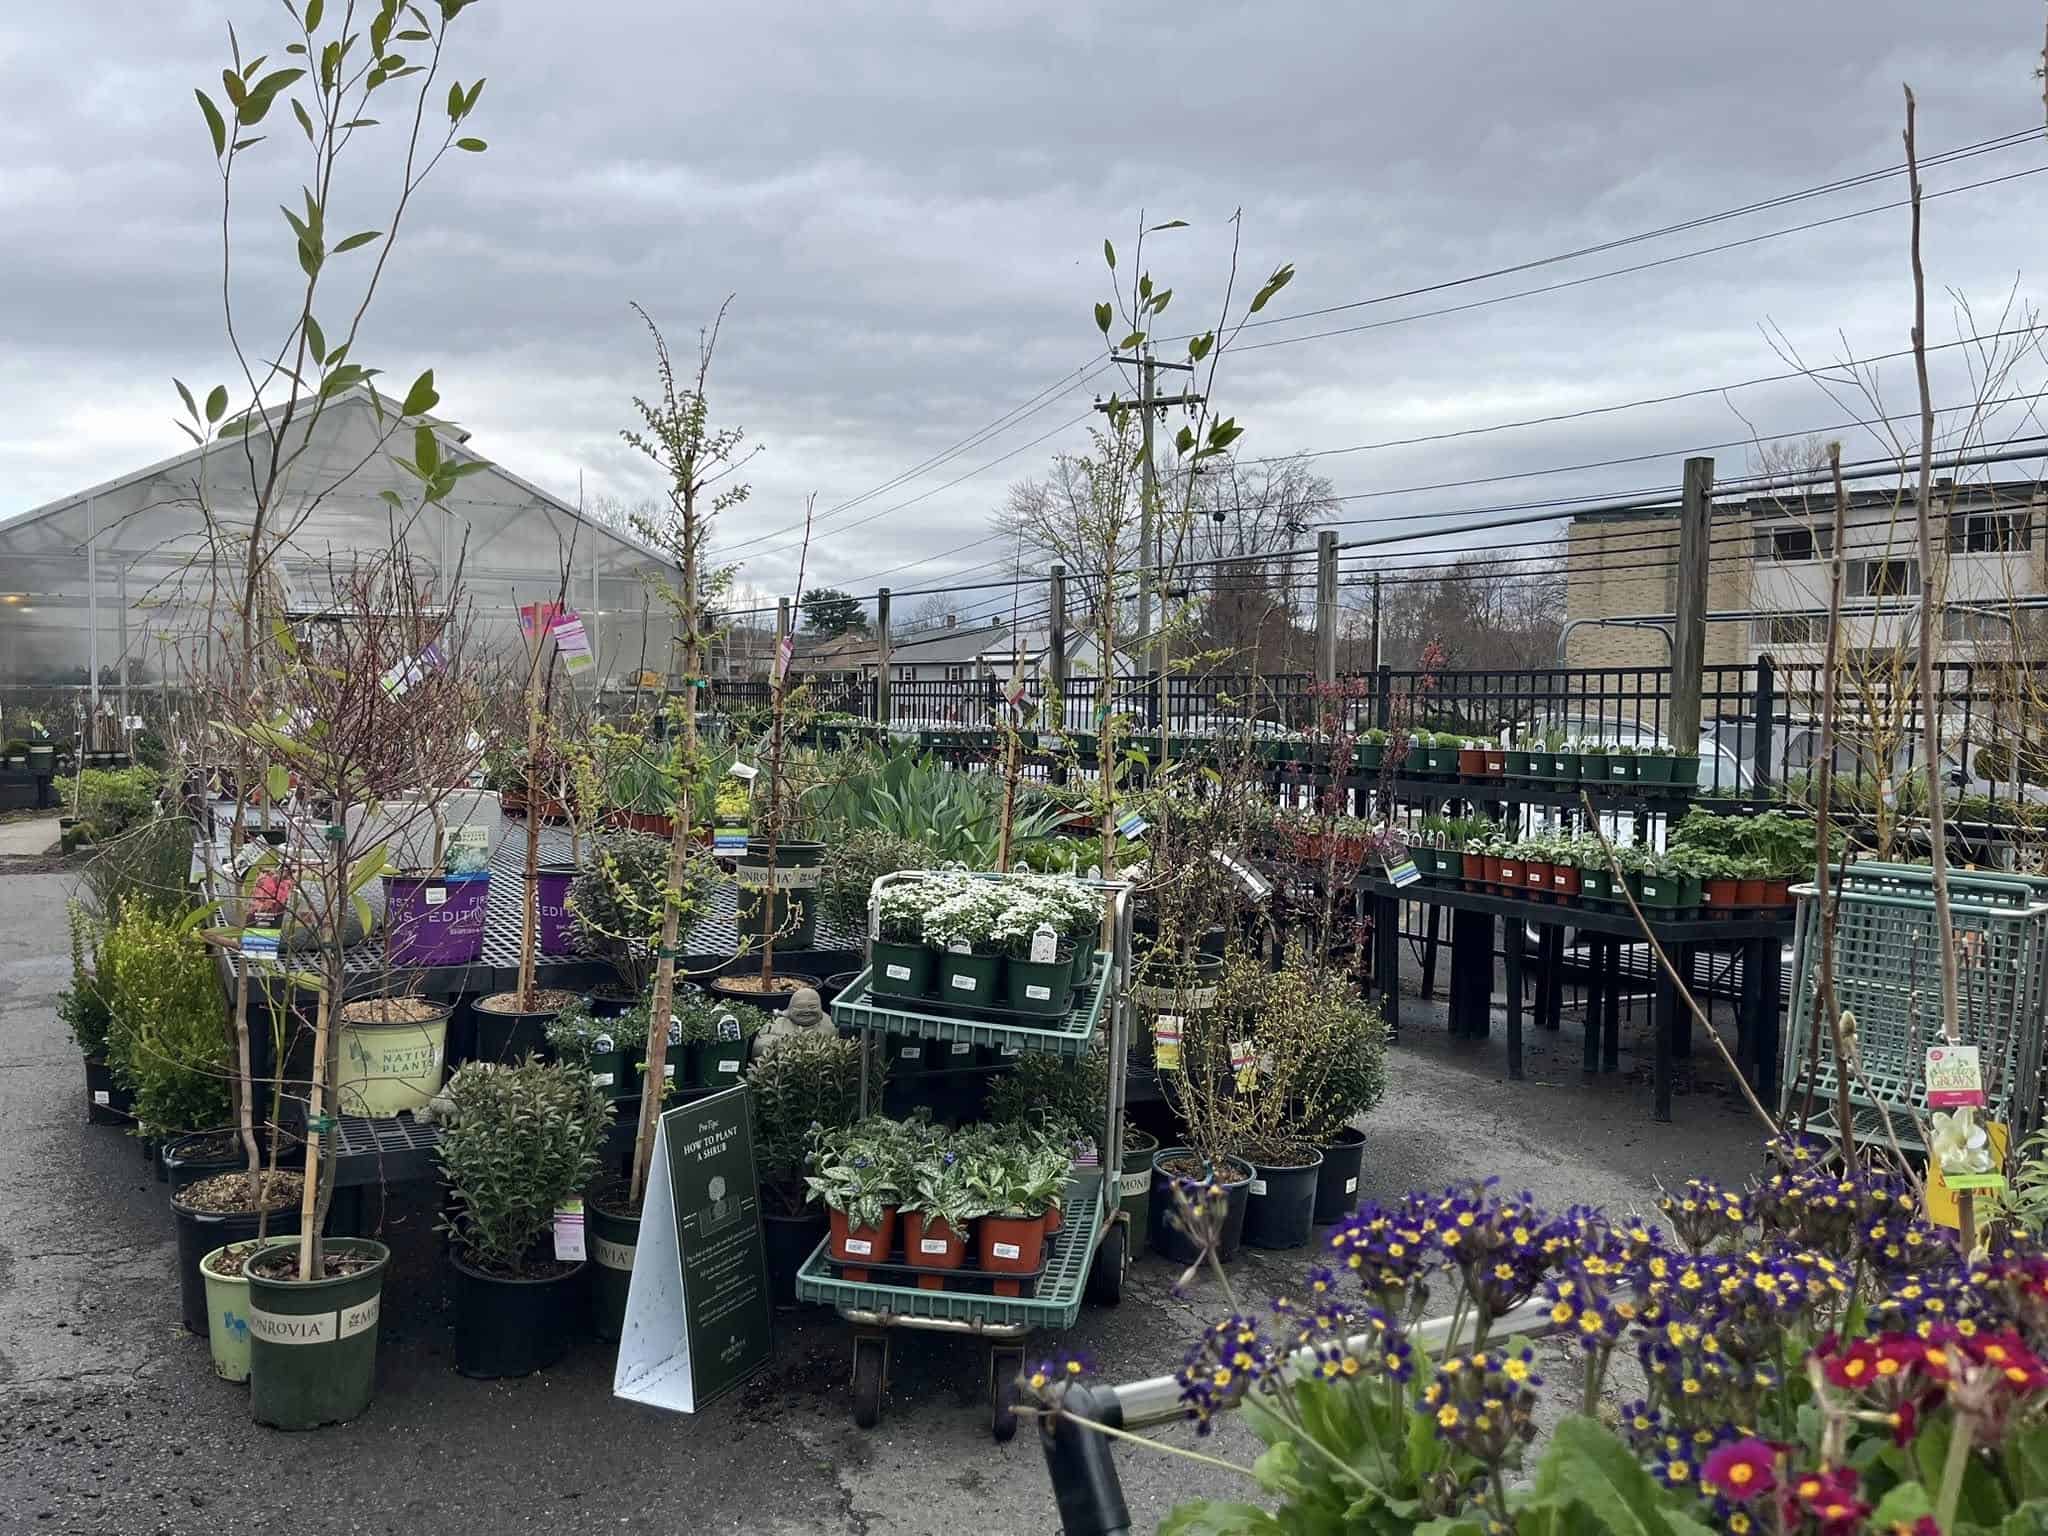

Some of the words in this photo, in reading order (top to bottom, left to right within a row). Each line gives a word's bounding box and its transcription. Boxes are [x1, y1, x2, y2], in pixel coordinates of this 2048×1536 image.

[684, 1139, 702, 1155] HOW
[703, 1135, 714, 1147] TO
[715, 1126, 737, 1142] PLANT
[697, 1152, 702, 1163] A
[703, 1142, 727, 1159] SHRUB
[255, 1319, 320, 1337] NROVIA
